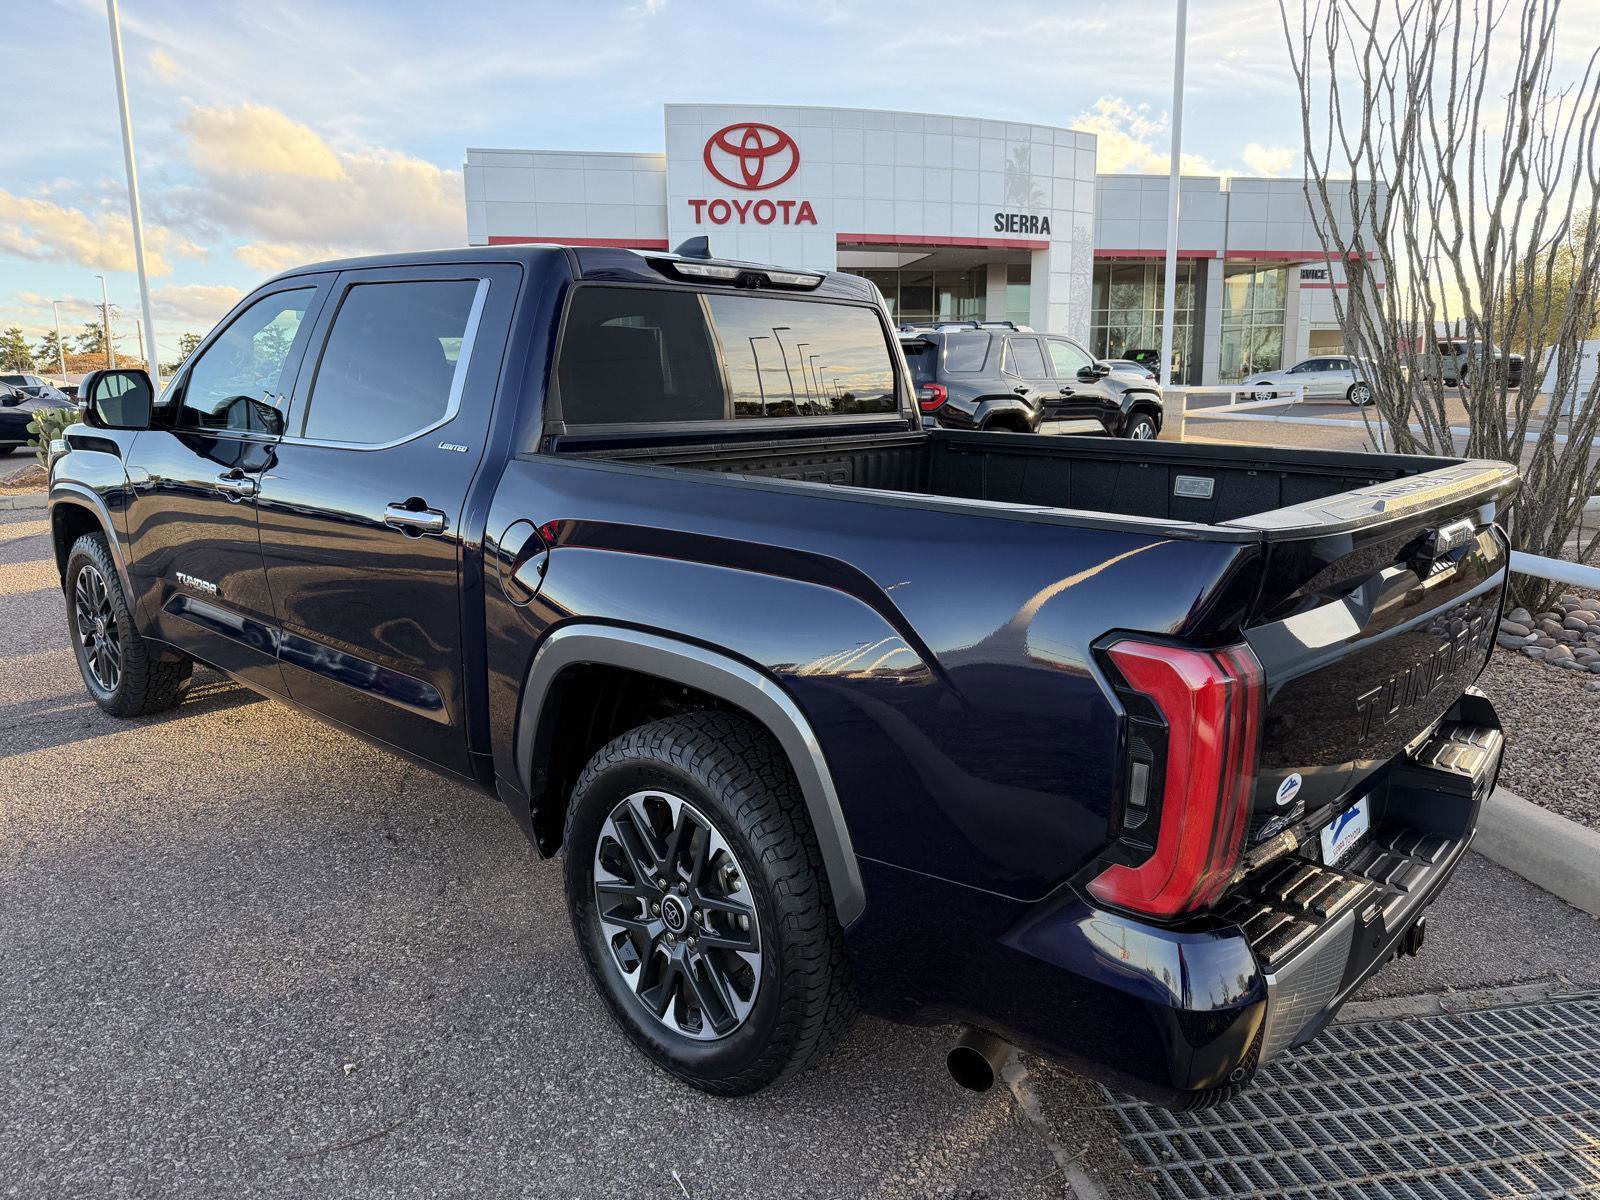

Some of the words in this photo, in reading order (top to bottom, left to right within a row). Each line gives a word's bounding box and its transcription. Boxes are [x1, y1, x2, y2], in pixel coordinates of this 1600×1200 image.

[688, 199, 817, 225] TOYOTA
[994, 212, 1051, 235] SIERRA
[176, 572, 218, 596] TUNDRA
[1356, 616, 1484, 744] TUNDRA
